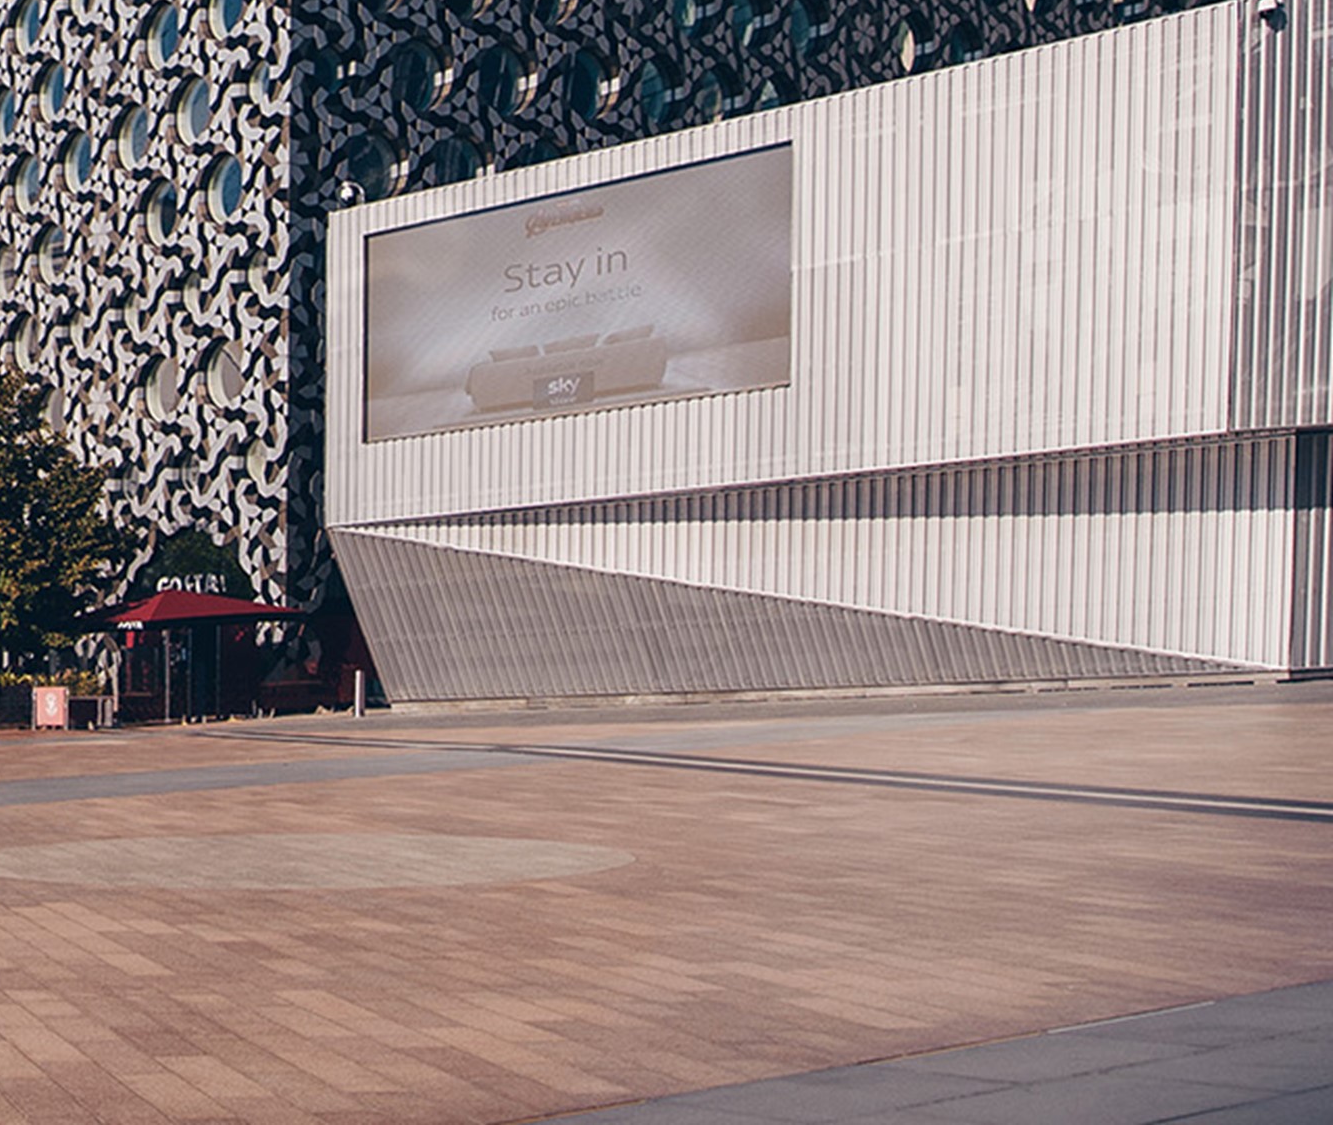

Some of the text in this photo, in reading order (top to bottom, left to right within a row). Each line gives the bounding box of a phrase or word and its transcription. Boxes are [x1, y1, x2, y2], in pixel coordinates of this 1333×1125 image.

[504, 247, 628, 293] Stay in
[491, 306, 516, 322] for
[520, 303, 541, 317] an
[545, 294, 581, 315] epic
[548, 377, 581, 395] sky
